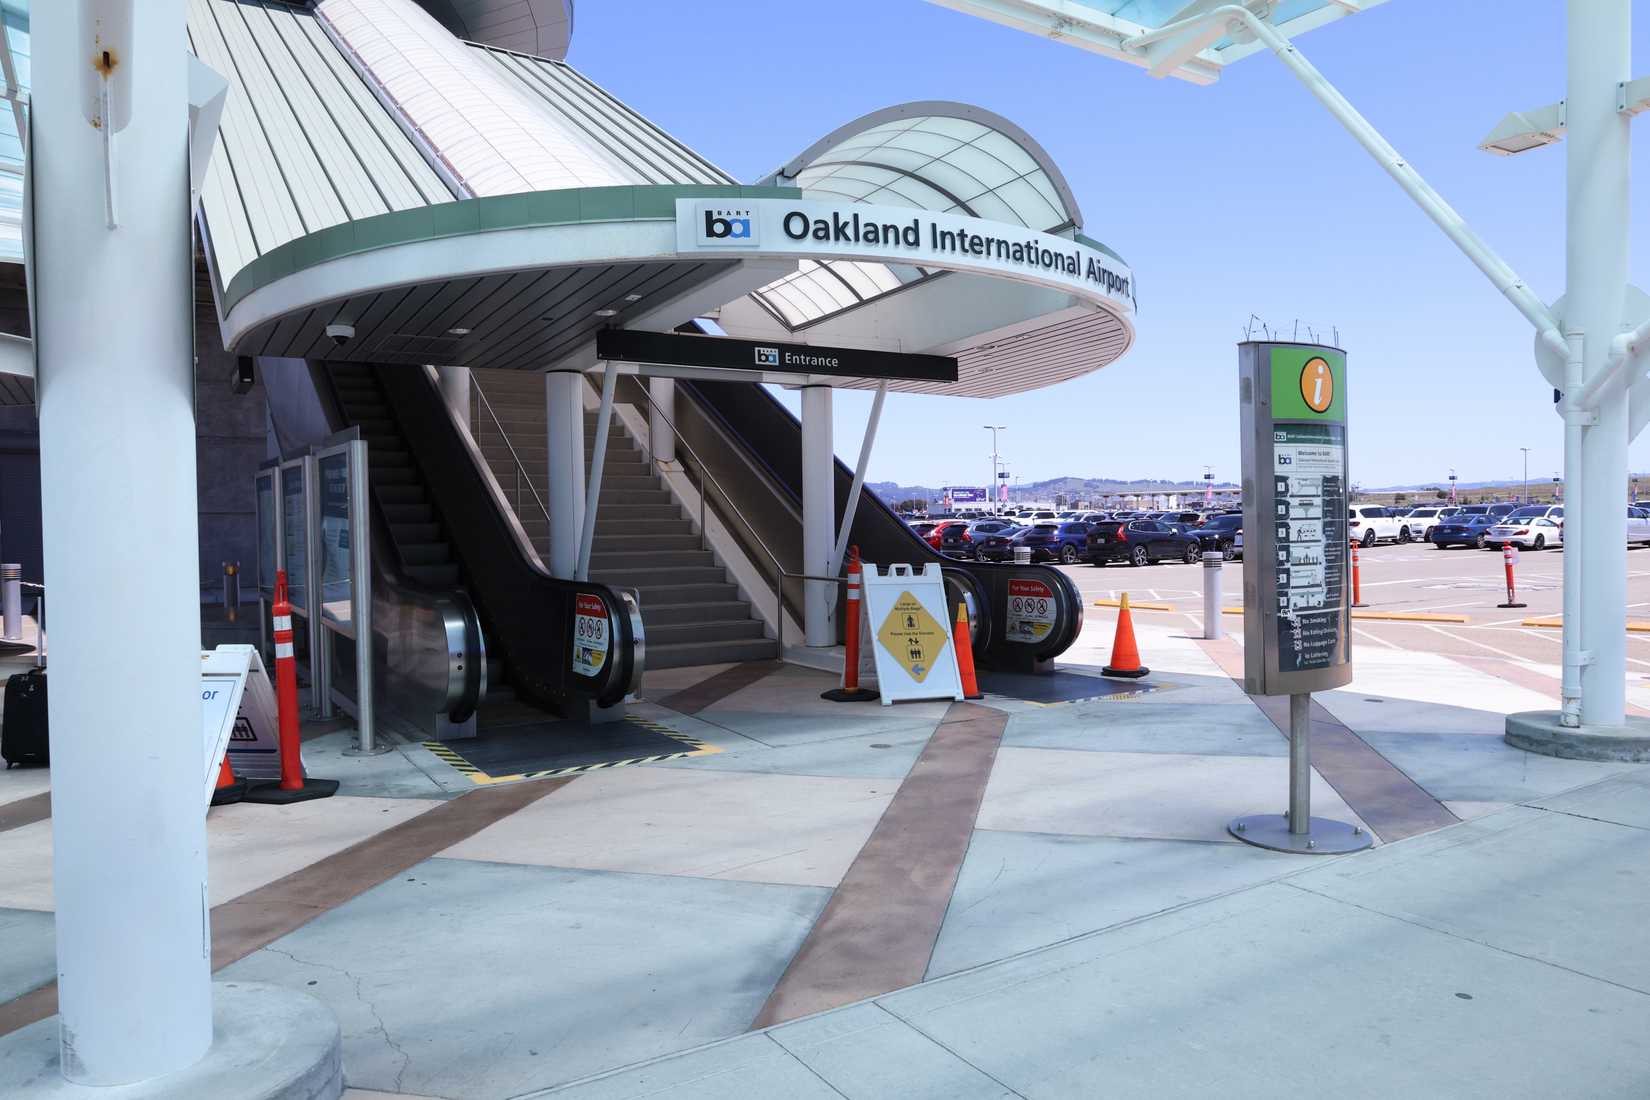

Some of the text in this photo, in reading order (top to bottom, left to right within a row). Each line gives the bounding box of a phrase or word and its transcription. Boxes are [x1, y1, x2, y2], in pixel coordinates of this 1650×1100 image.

[783, 211, 1130, 298] Oakland International Airport
[785, 352, 838, 367] Entrance
[202, 690, 220, 700] or
